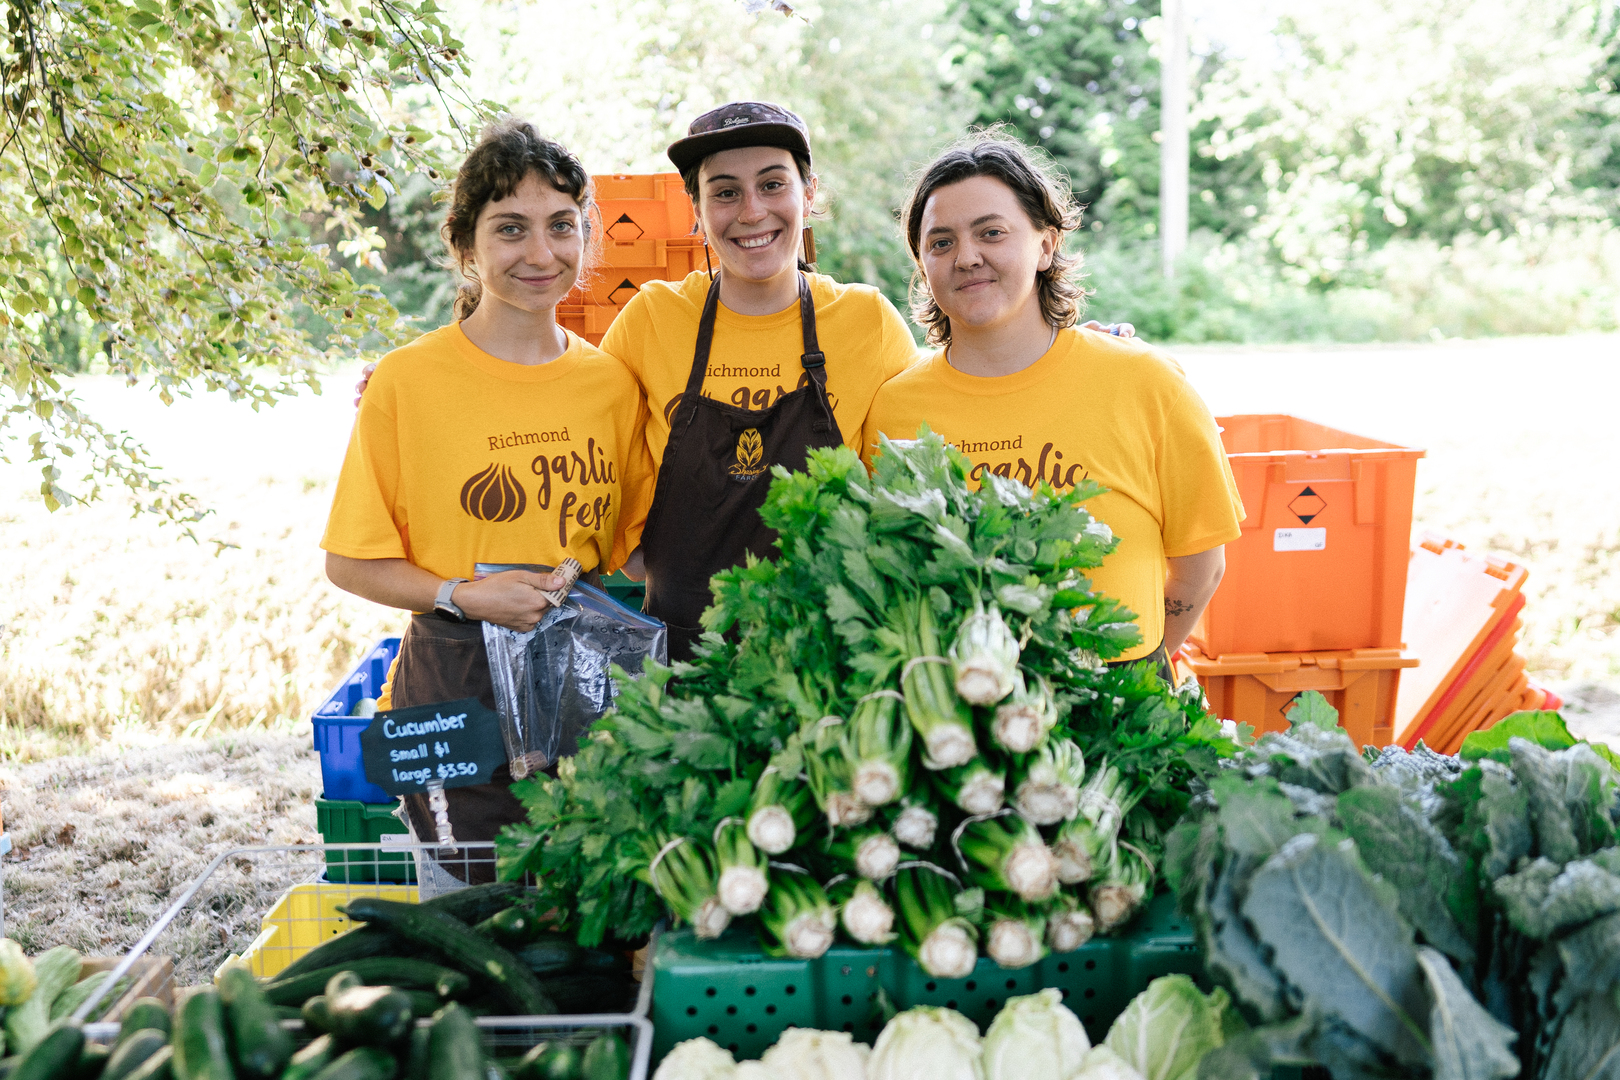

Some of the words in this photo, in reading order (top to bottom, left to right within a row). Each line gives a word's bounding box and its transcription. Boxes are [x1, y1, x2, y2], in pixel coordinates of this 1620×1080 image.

[704, 363, 781, 378] ichmond
[487, 426, 571, 451] Richmond
[531, 437, 617, 511] garlic
[558, 491, 612, 549] fest
[382, 712, 468, 739] Cucumber
[389, 743, 428, 762] small
[434, 741, 450, 758] $1
[391, 767, 432, 785] large
[436, 762, 479, 780] $3.50
